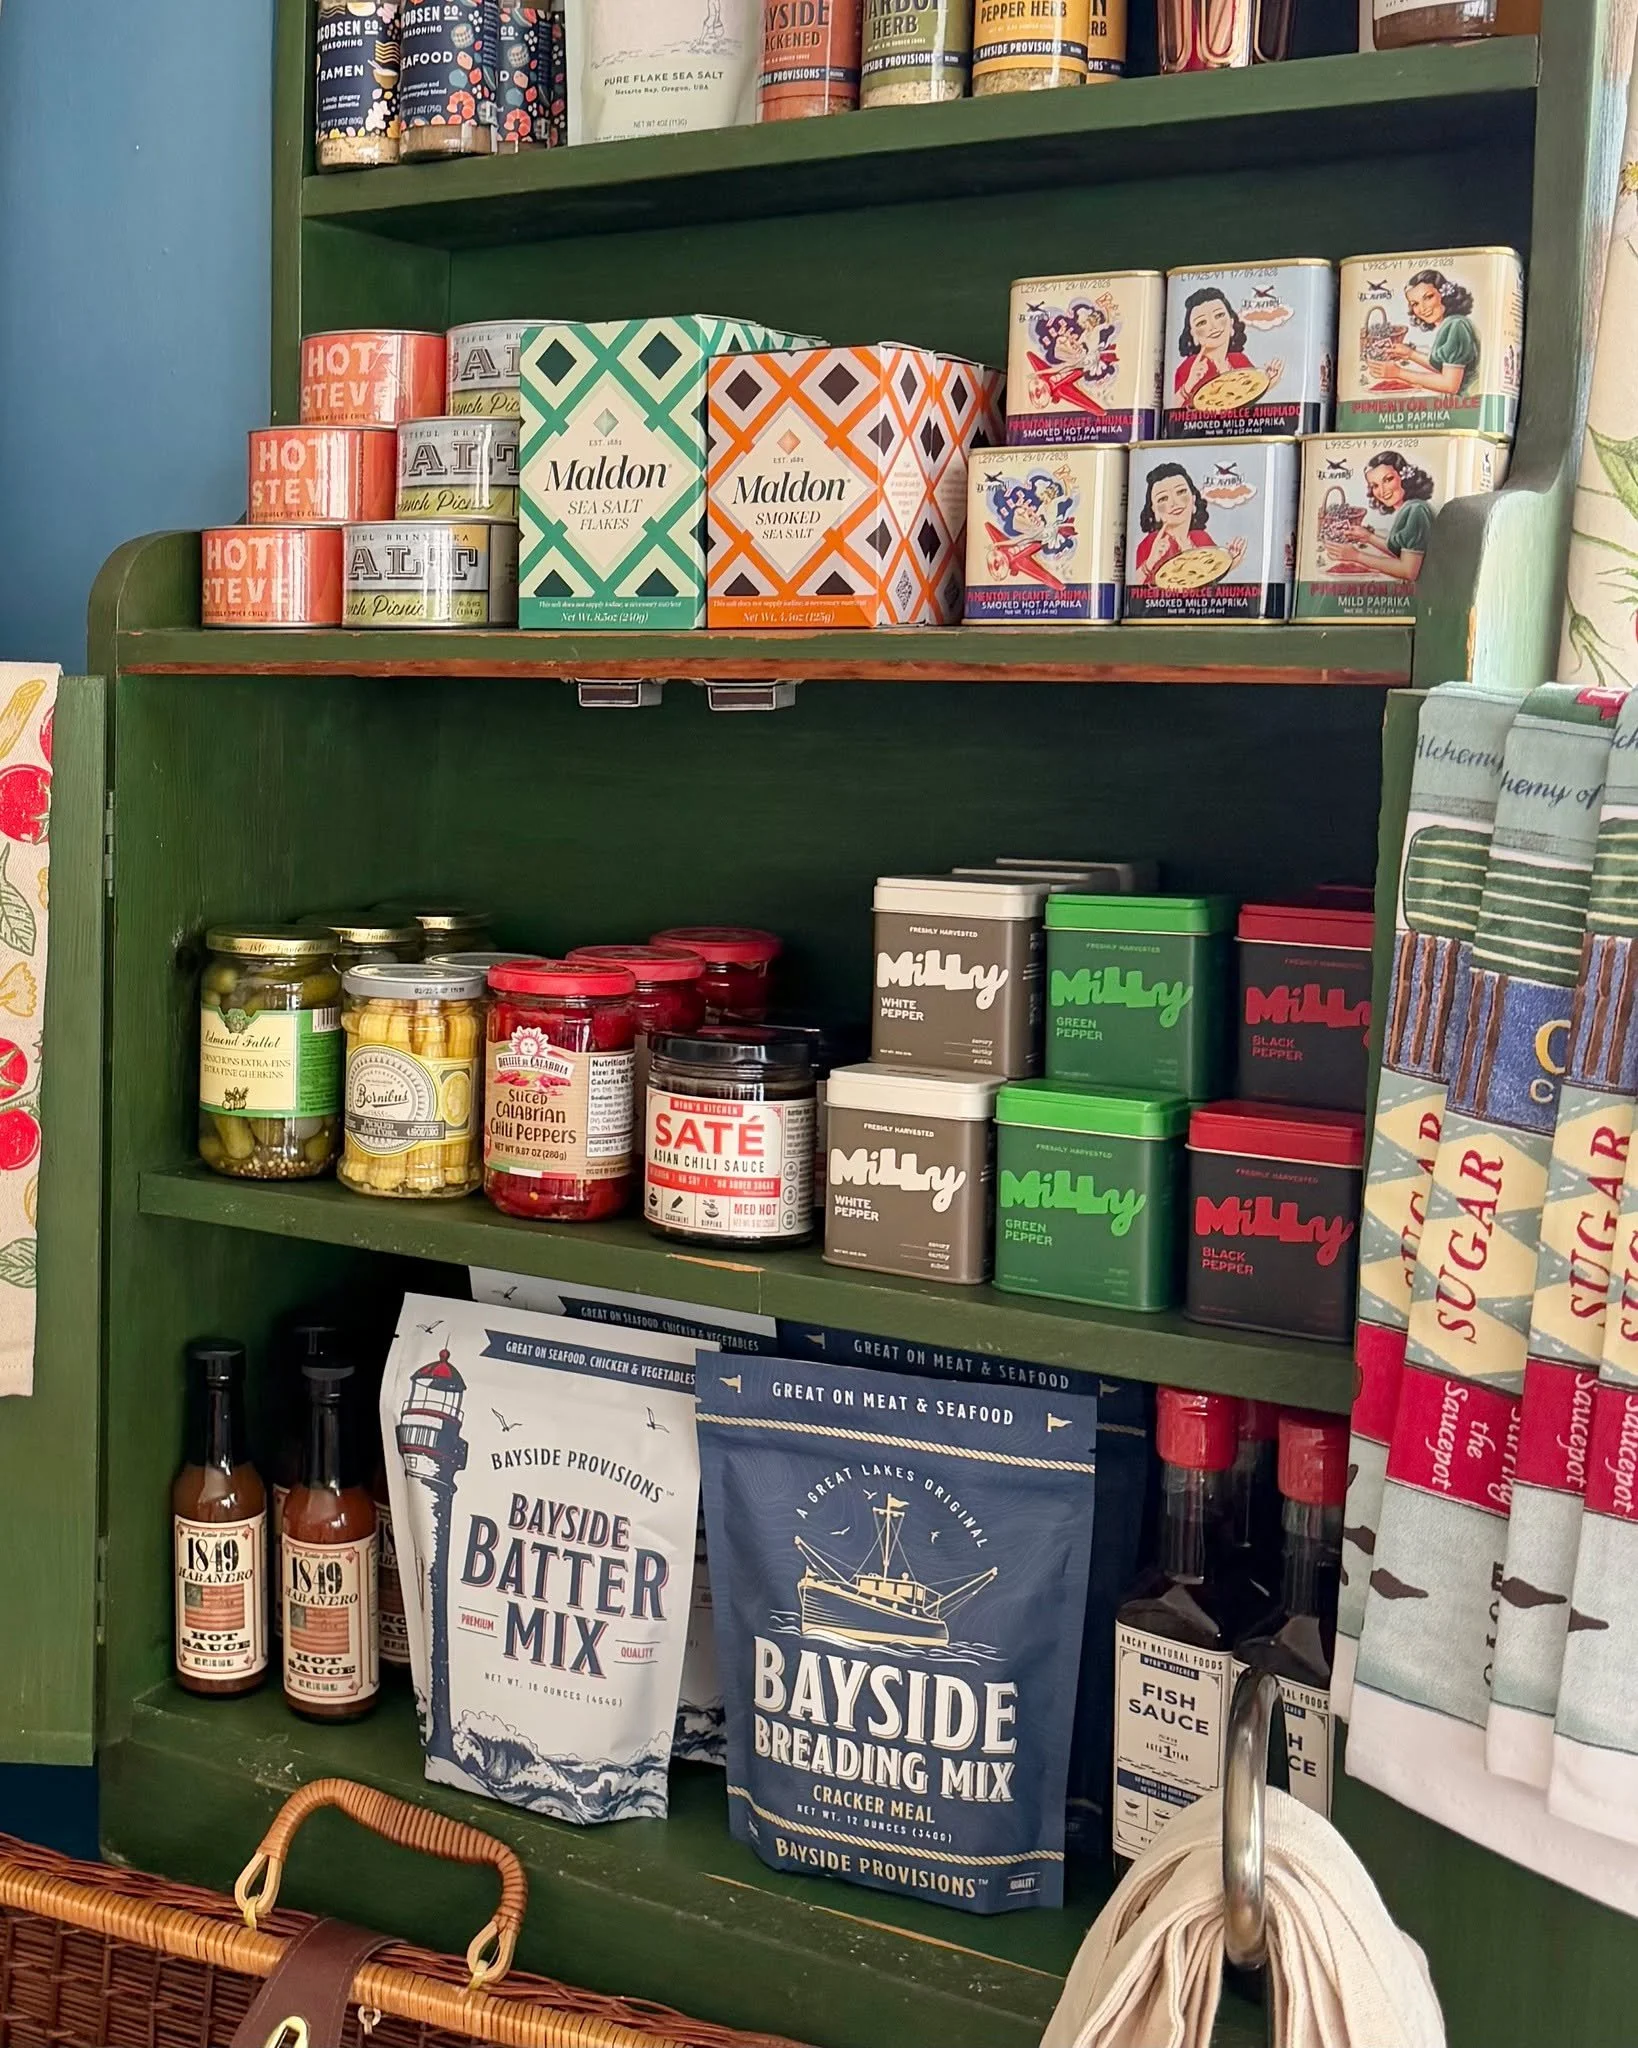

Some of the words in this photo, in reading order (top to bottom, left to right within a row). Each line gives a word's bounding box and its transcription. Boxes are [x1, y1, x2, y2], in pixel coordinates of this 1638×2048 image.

[444, 5, 462, 20] CO.
[766, 0, 829, 33] YSIDE
[981, 1, 1025, 24] PEPPER
[1030, 0, 1067, 18] HERB
[364, 20, 382, 34] CO.
[873, 14, 918, 40] HERB
[765, 31, 821, 51] ACKENED
[1010, 41, 1062, 55] PROVISIONS
[885, 53, 936, 69] PROVISIONS
[320, 65, 364, 81] RAMEN
[604, 75, 630, 86] PURE
[633, 73, 668, 83] FLAKE
[672, 72, 694, 80] SEA
[697, 71, 724, 80] SALT
[773, 68, 820, 84] PROVISIONS
[307, 341, 377, 377] HOT
[1184, 420, 1220, 431] SMOKED
[1222, 419, 1246, 429] MILD
[1247, 417, 1286, 427] PAPRIKA
[1378, 412, 1404, 424] MILD
[1407, 410, 1451, 421] PAPRIKA
[1023, 428, 1061, 438] SMOKED
[1063, 427, 1082, 436] HOT
[1084, 424, 1123, 435] PAPRIKA
[544, 454, 667, 493] Maldon
[732, 471, 846, 505] Maldon
[567, 499, 598, 515] SEA
[602, 499, 643, 515] SALT
[580, 518, 630, 531] FLAKES
[755, 510, 821, 526] SMOKED
[762, 529, 785, 540] SEA
[787, 528, 814, 539] SALT
[206, 535, 277, 571] HOT
[348, 544, 479, 582] ALT
[372, 594, 425, 616] Picnic
[981, 601, 1019, 610] SMOKED
[1021, 600, 1041, 609] HOT
[1043, 599, 1082, 609] PAPRIKA
[1145, 598, 1184, 609] SMOKED
[1185, 598, 1208, 608] MILD
[1210, 597, 1248, 607] PAPRIKA
[1337, 596, 1364, 607] MILD
[1366, 596, 1410, 607] PAPRIKA
[560, 612, 576, 622] Net
[743, 612, 759, 622] Net
[1576, 780, 1604, 810] of
[909, 926, 937, 935] FRESHLY
[939, 928, 978, 938] HARVESTED
[876, 949, 1009, 1010] Milly
[880, 997, 917, 1010] WHITE
[1050, 966, 1194, 1028] Milly
[880, 1008, 924, 1021] PEPPER
[1056, 1016, 1097, 1030] GREEN
[242, 1034, 281, 1049] Fallot
[1056, 1027, 1103, 1041] PEPPER
[1252, 1034, 1295, 1049] BLACK
[592, 1058, 626, 1068] Nutrition
[1252, 1046, 1304, 1062] PEPPER
[530, 1056, 569, 1075] CALABRIA
[355, 1083, 409, 1108] Bornibus
[655, 1112, 764, 1157] SATÉ
[864, 1122, 893, 1133] FRESHLY
[895, 1126, 935, 1138] HARVESTED
[504, 1145, 514, 1153] WT
[531, 1148, 542, 1158] OZ
[653, 1149, 679, 1165] ASIAN
[684, 1155, 718, 1171] CHILI
[724, 1160, 765, 1173] SAUCE
[829, 1148, 967, 1213] Milly
[734, 1203, 756, 1216] MED
[759, 1203, 777, 1216] HOT
[834, 1194, 872, 1210] WHITE
[1000, 1170, 1146, 1238] Milly
[834, 1206, 879, 1222] PEPPER
[1005, 1218, 1047, 1233] GREEN
[1195, 1195, 1354, 1267] Milly
[1005, 1230, 1053, 1247] PEPPER
[1435, 1148, 1504, 1344] SUGAR
[1202, 1246, 1246, 1263] BLACK
[1201, 1258, 1254, 1276] PEPPER
[580, 1306, 608, 1320] GREAT
[662, 1321, 696, 1339] CHICKEN
[505, 1340, 533, 1358] GREAT
[534, 1345, 547, 1360] ON
[589, 1353, 629, 1374] CHICKEN
[640, 1364, 695, 1386] VEGETABLES
[853, 1339, 899, 1361] GREAT
[907, 1348, 927, 1363] ON
[933, 1351, 973, 1374] MEAT
[999, 1364, 1070, 1391] SEAFOOD
[772, 1381, 825, 1403] GREAT
[832, 1389, 855, 1405] ON
[862, 1391, 908, 1412] MEAT
[915, 1397, 928, 1414] &
[936, 1399, 1014, 1426] SEAFOOD
[1426, 1380, 1469, 1491] Saucepot
[1466, 1419, 1497, 1460] the
[1556, 1373, 1598, 1488] Saucepot
[1604, 1395, 1638, 1514] Saucepot
[491, 1447, 562, 1471] BAYSIDE
[567, 1450, 663, 1503] PROVISIONS
[808, 1466, 852, 1504] GREAT
[861, 1464, 915, 1483] LAKES
[923, 1478, 988, 1549] ORIGINAL
[508, 1493, 632, 1552] BAYSIDE
[187, 1537, 239, 1573] 1849
[179, 1566, 253, 1584] HABANERO
[292, 1556, 343, 1595] 1849
[460, 1514, 670, 1622] BATTER
[285, 1585, 358, 1606] HABANERO
[461, 1613, 494, 1632] PREMIUM
[181, 1637, 250, 1652] SAUCE
[191, 1630, 238, 1641] HOT
[503, 1601, 609, 1680] MIX
[295, 1652, 342, 1665] HOT
[620, 1645, 654, 1660] QUALITY
[1151, 1643, 1189, 1663] NATURAL
[1193, 1655, 1223, 1670] FOODS
[288, 1658, 355, 1676] SAUCE
[484, 1671, 502, 1684] NET
[542, 1684, 582, 1701] OUNCES
[754, 1635, 1019, 1755] BAYSIDE
[1142, 1682, 1196, 1711] FISH
[1300, 1692, 1329, 1710] FOODS
[1128, 1698, 1209, 1736] SAUCE
[754, 1712, 929, 1796] BREADING
[940, 1756, 1015, 1804] MIX
[813, 1784, 884, 1815] CRACKER
[890, 1801, 936, 1824] MEAL
[796, 1803, 816, 1818] NET
[822, 1809, 841, 1823] WT.
[846, 1814, 858, 1826] 12
[863, 1817, 907, 1835] OUNCES
[775, 1837, 852, 1873] BAYSIDE
[859, 1857, 977, 1899] PROVISIONS
[1009, 1875, 1037, 1890] QUALITY
